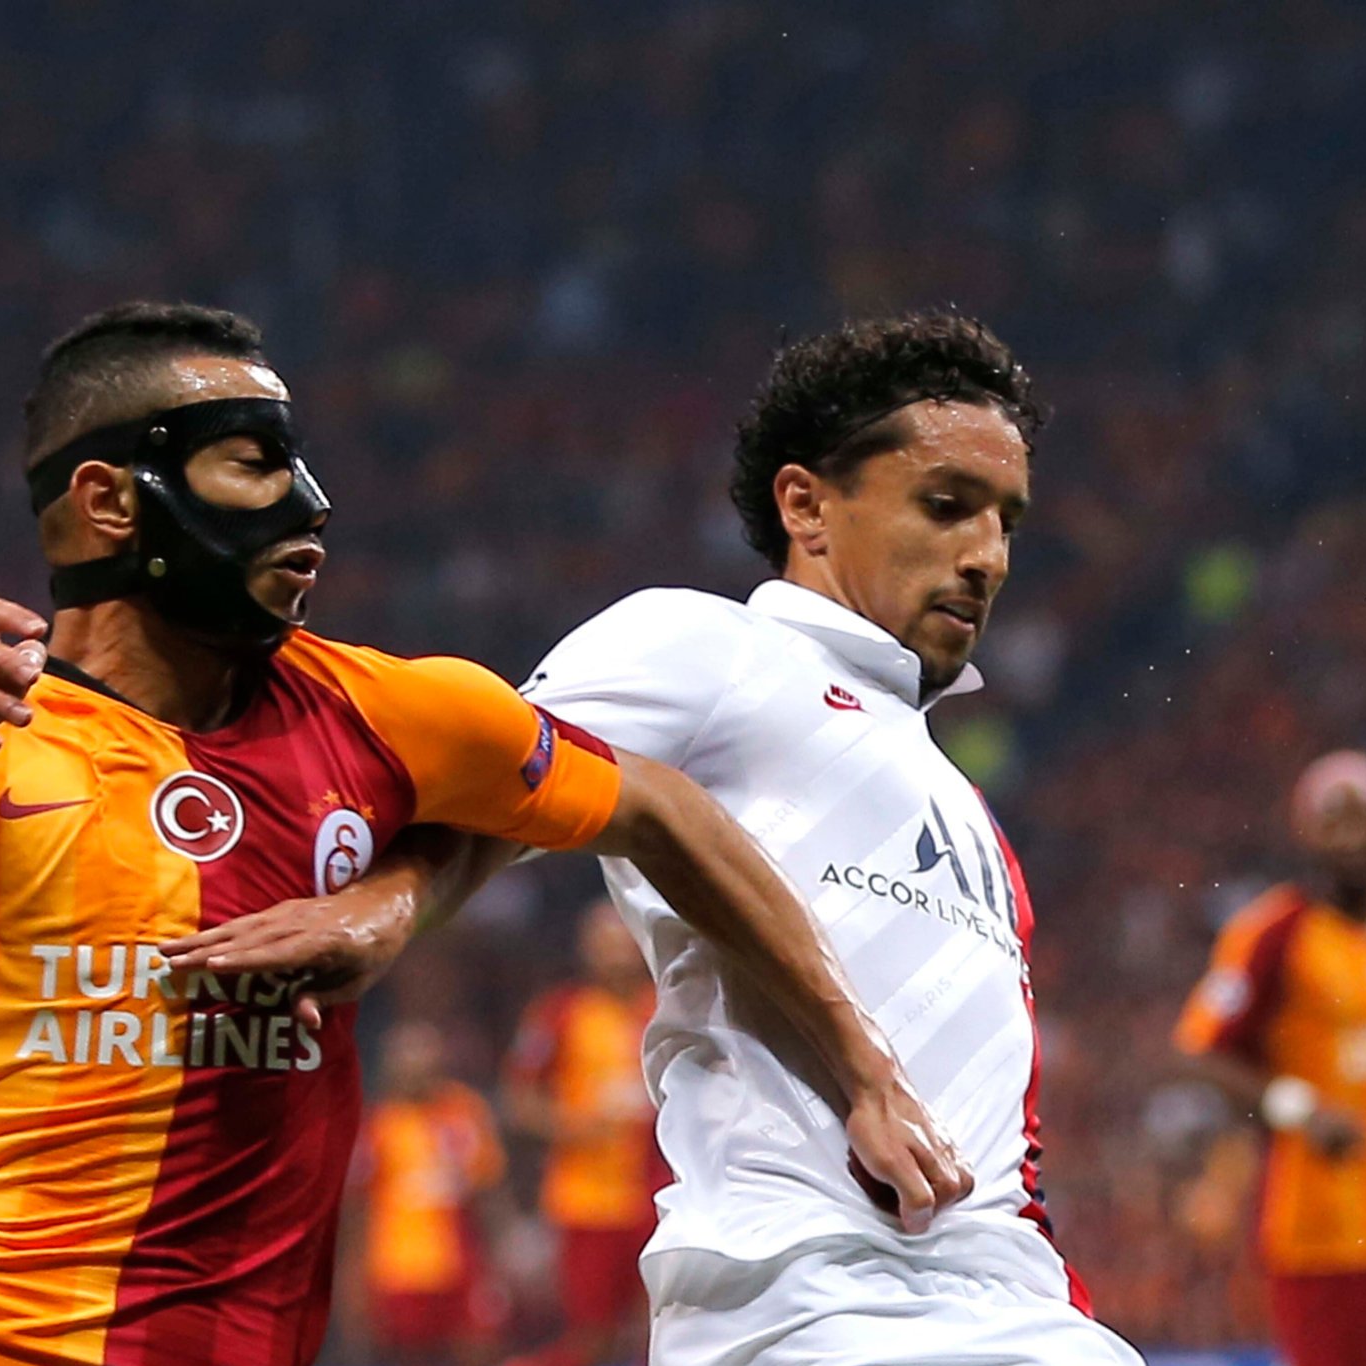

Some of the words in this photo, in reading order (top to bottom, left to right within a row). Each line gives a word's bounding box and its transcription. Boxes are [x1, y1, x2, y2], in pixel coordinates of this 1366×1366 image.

[820, 862, 932, 915] ACCOR
[936, 898, 990, 940] LIVE
[31, 944, 316, 1006] TURKIS
[17, 1009, 323, 1072] AIRLINES
